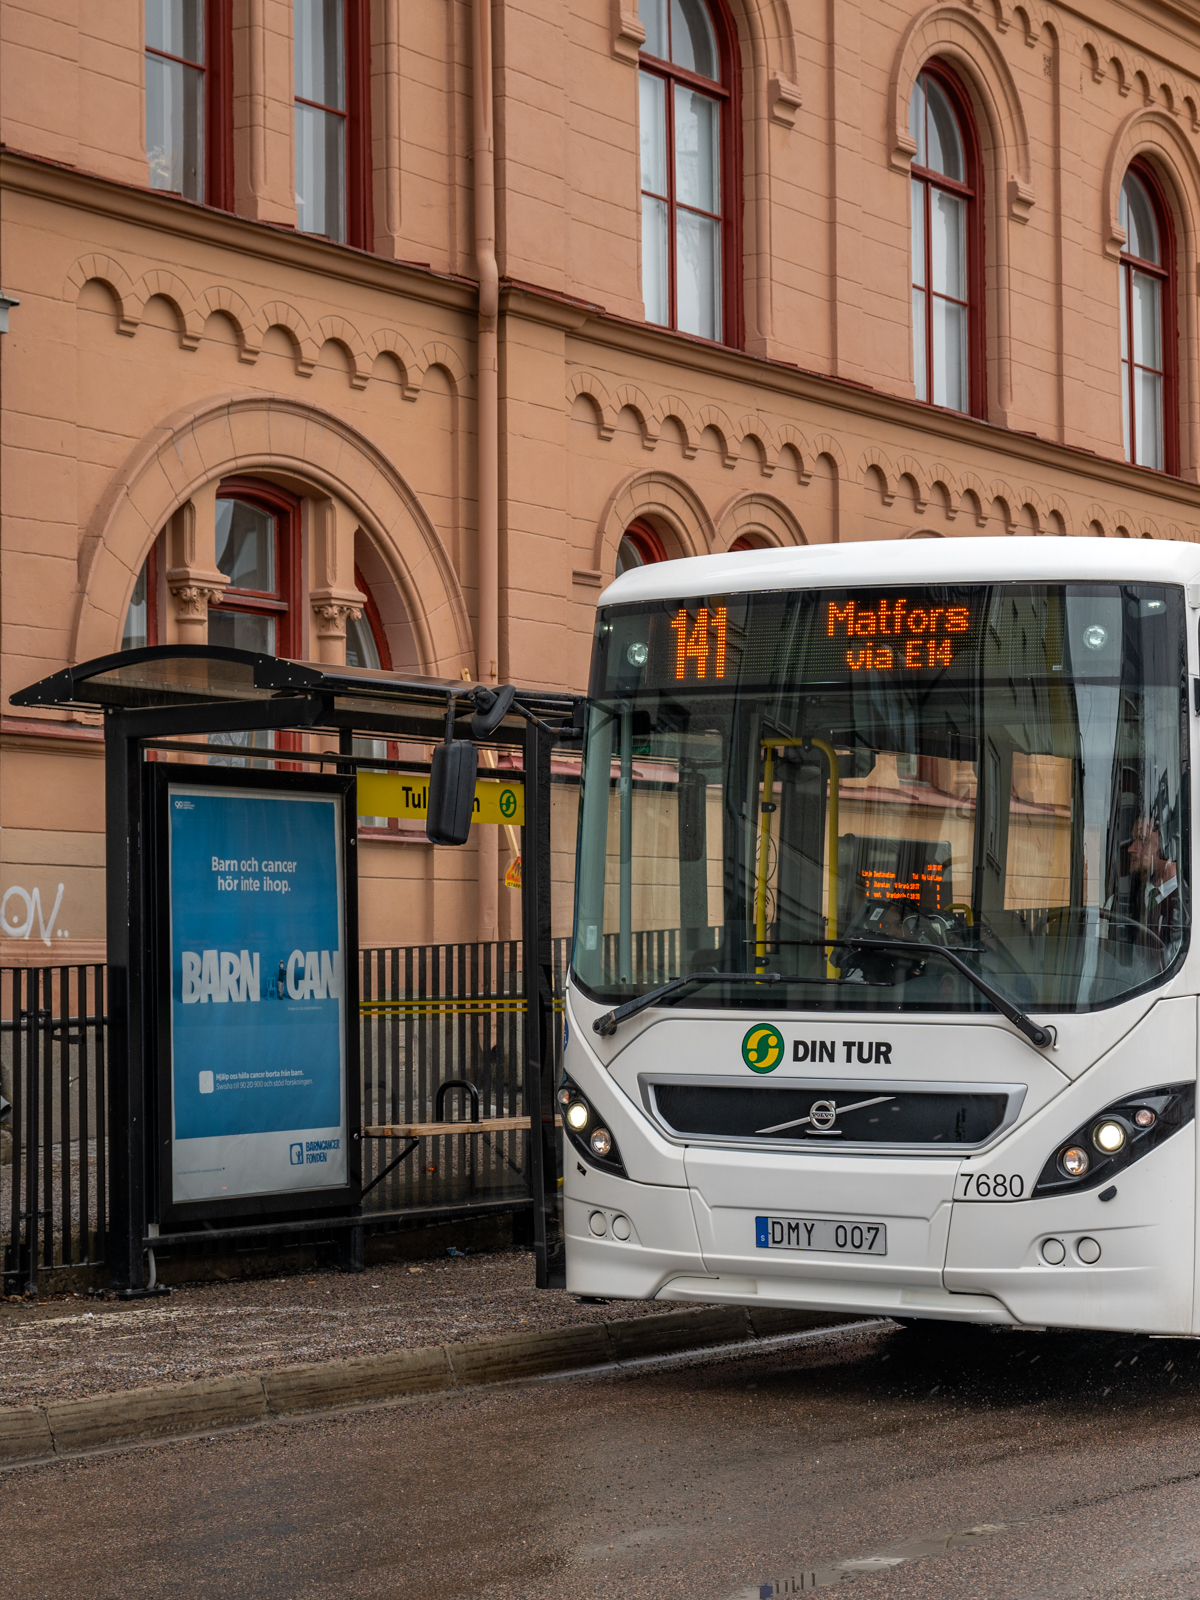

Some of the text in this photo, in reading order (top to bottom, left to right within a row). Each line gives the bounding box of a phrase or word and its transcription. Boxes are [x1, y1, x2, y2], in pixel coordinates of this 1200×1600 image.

[827, 599, 969, 636] Matfors
[670, 607, 727, 679] 141
[846, 639, 953, 669] via E14
[211, 856, 297, 873] Barn och cancer
[217, 876, 291, 894] hör inte ihop.
[181, 949, 340, 1004] BARN CAN
[792, 1039, 893, 1065] DIN TUR
[216, 1073, 229, 1082] Hjälp
[238, 1071, 249, 1079] hålla
[265, 1070, 280, 1078] borta
[280, 1069, 290, 1077] från
[216, 1081, 233, 1090] Swisha
[273, 1079, 284, 1087] stöd
[284, 1078, 313, 1087] forskningen.
[305, 1139, 340, 1152] BARNCANCER
[306, 1152, 327, 1164] FONDEN
[960, 1173, 1025, 1198] 7680
[771, 1220, 815, 1246] DMY
[835, 1225, 880, 1250] 007
